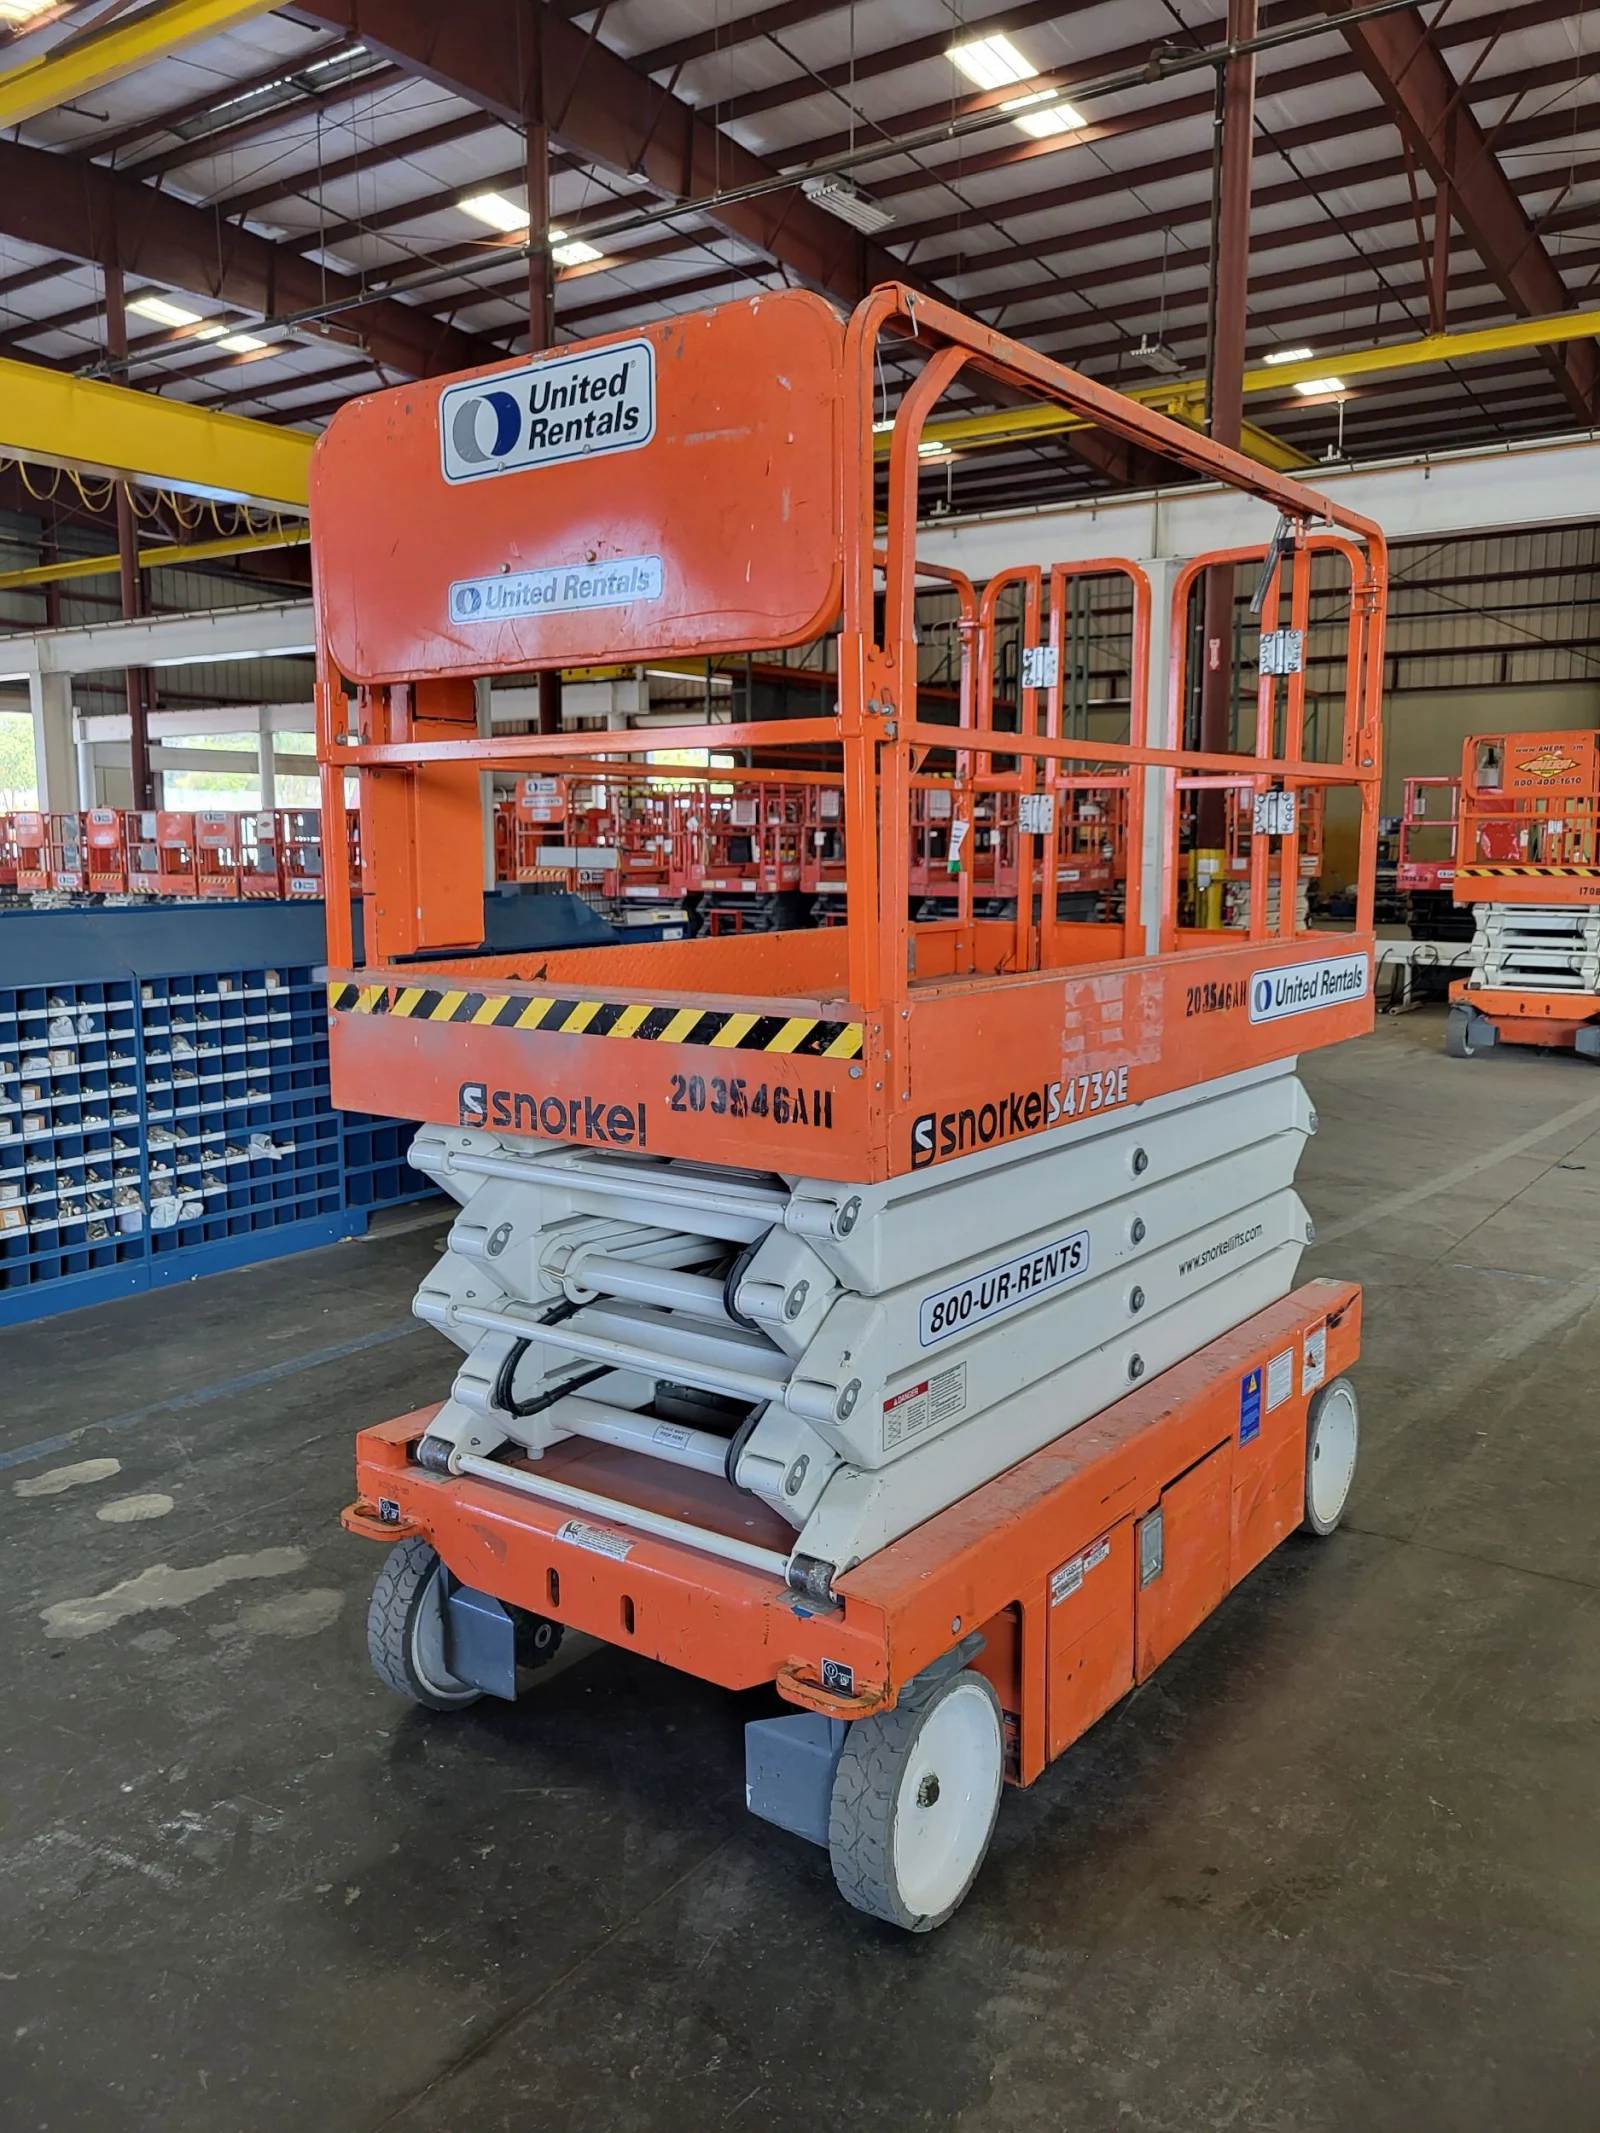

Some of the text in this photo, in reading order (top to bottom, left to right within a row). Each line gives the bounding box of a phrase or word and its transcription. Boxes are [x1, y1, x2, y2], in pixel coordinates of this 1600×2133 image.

[529, 362, 630, 414] United
[528, 400, 639, 450] Rentals
[485, 566, 650, 610] United Rentals
[1514, 777, 1582, 787] 800-400-1610
[1275, 964, 1362, 1007] United Rentals
[492, 1091, 646, 1147] snorkel
[940, 1084, 1049, 1156] snorkel
[1047, 1065, 1129, 1123] S4732E
[1178, 1224, 1263, 1277] www.snorkellifts.com
[930, 1240, 1082, 1333] 800-UR-RENTS
[898, 1387, 919, 1404] DANGER
